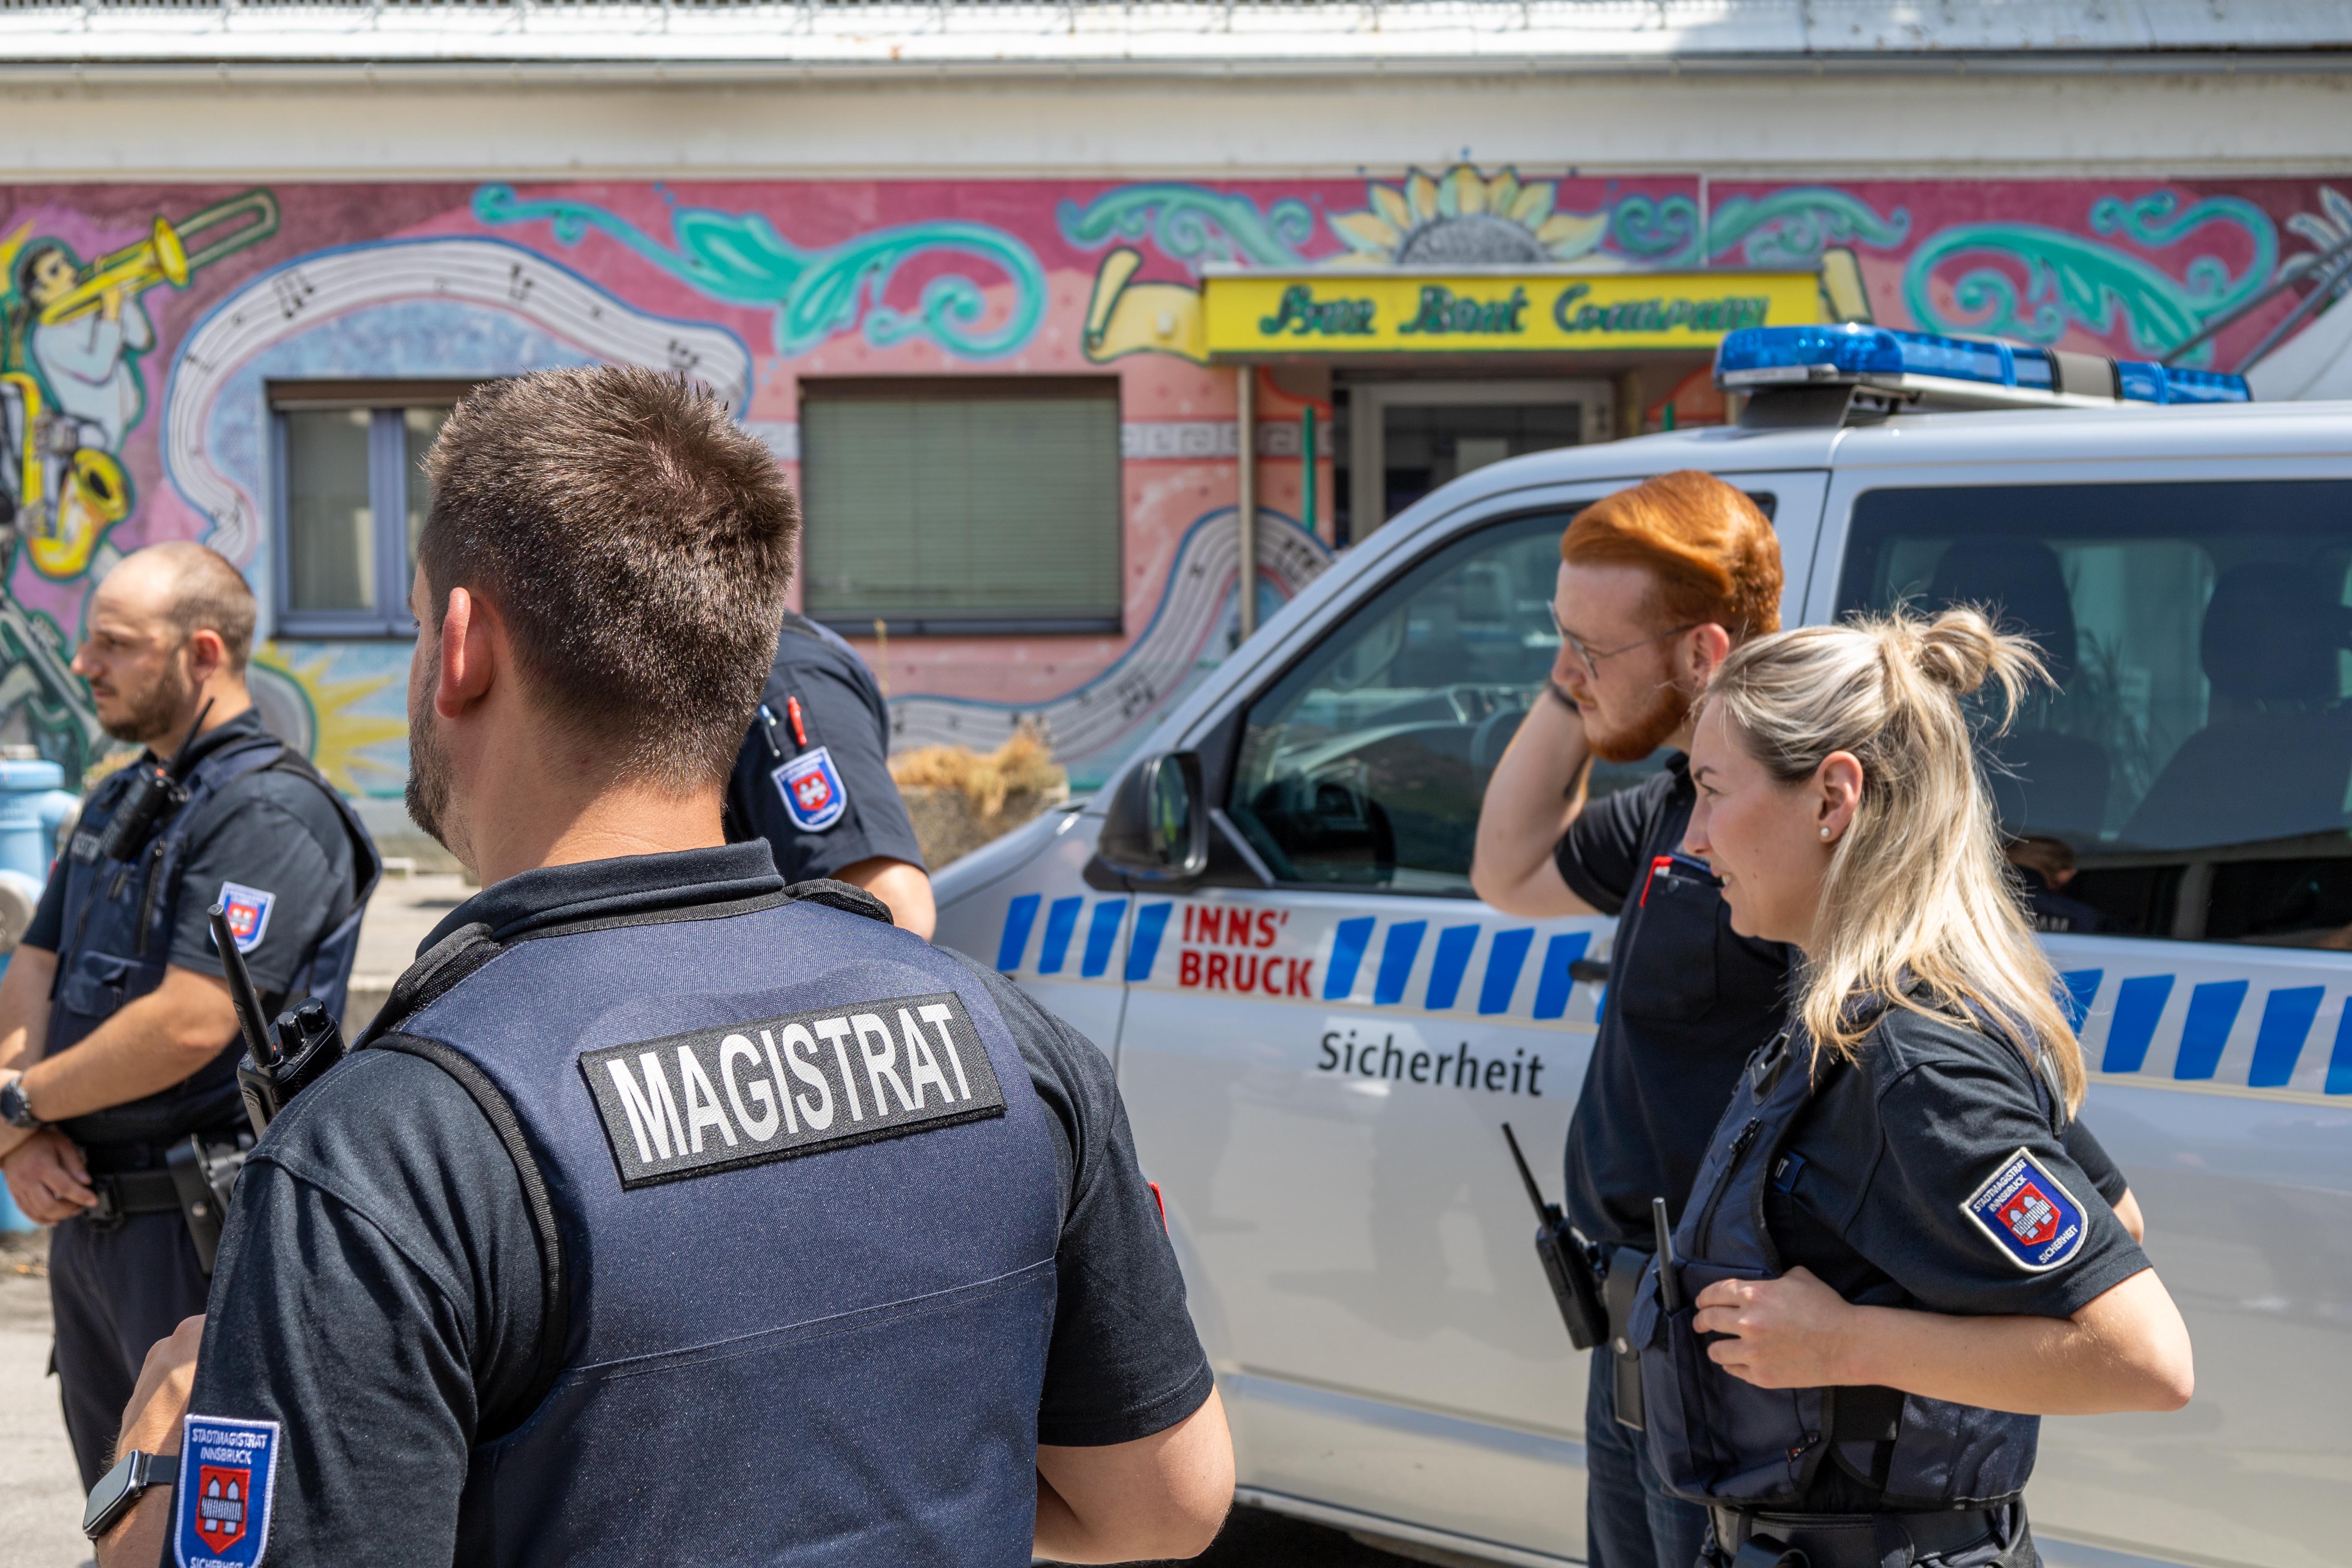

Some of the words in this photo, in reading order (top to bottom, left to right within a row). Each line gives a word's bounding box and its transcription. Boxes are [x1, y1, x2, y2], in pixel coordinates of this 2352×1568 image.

[1179, 951, 1313, 997] BRUCK
[606, 1004, 971, 1163] MAGISTRAT
[1318, 1031, 1544, 1096] Sicherheit
[1973, 1159, 2027, 1212] STADTMAGISTRAT
[1988, 1174, 2027, 1212] INNSBRUCK
[2039, 1224, 2078, 1263] SICHERHEIT
[192, 1429, 267, 1449] STADTMAGISTRAT
[201, 1448, 251, 1464] INNSBRUCK
